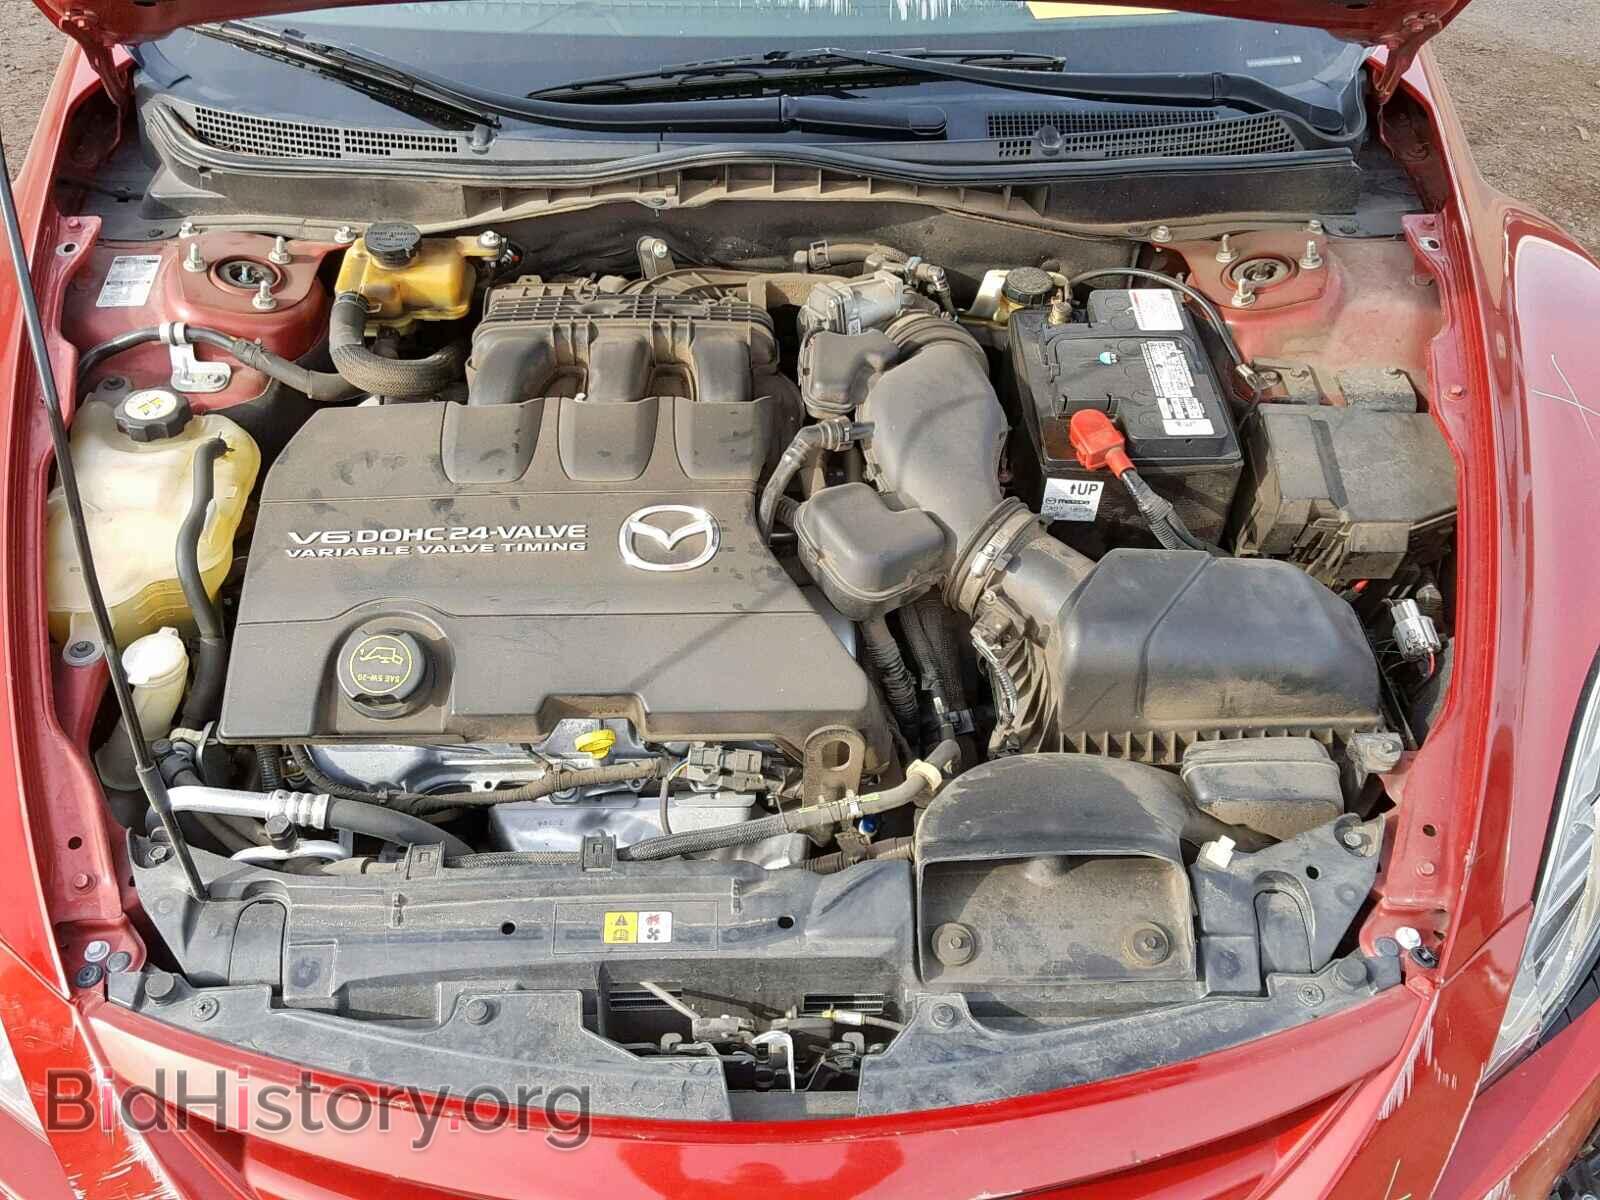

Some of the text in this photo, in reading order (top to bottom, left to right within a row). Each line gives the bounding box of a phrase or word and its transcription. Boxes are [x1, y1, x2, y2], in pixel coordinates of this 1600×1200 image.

[1077, 483, 1099, 495] UP
[287, 524, 588, 545] V6 DOHC 24-VALVE
[285, 541, 587, 559] VARIABLE VALVE TIMING
[357, 673, 401, 684] SAE 5W-20
